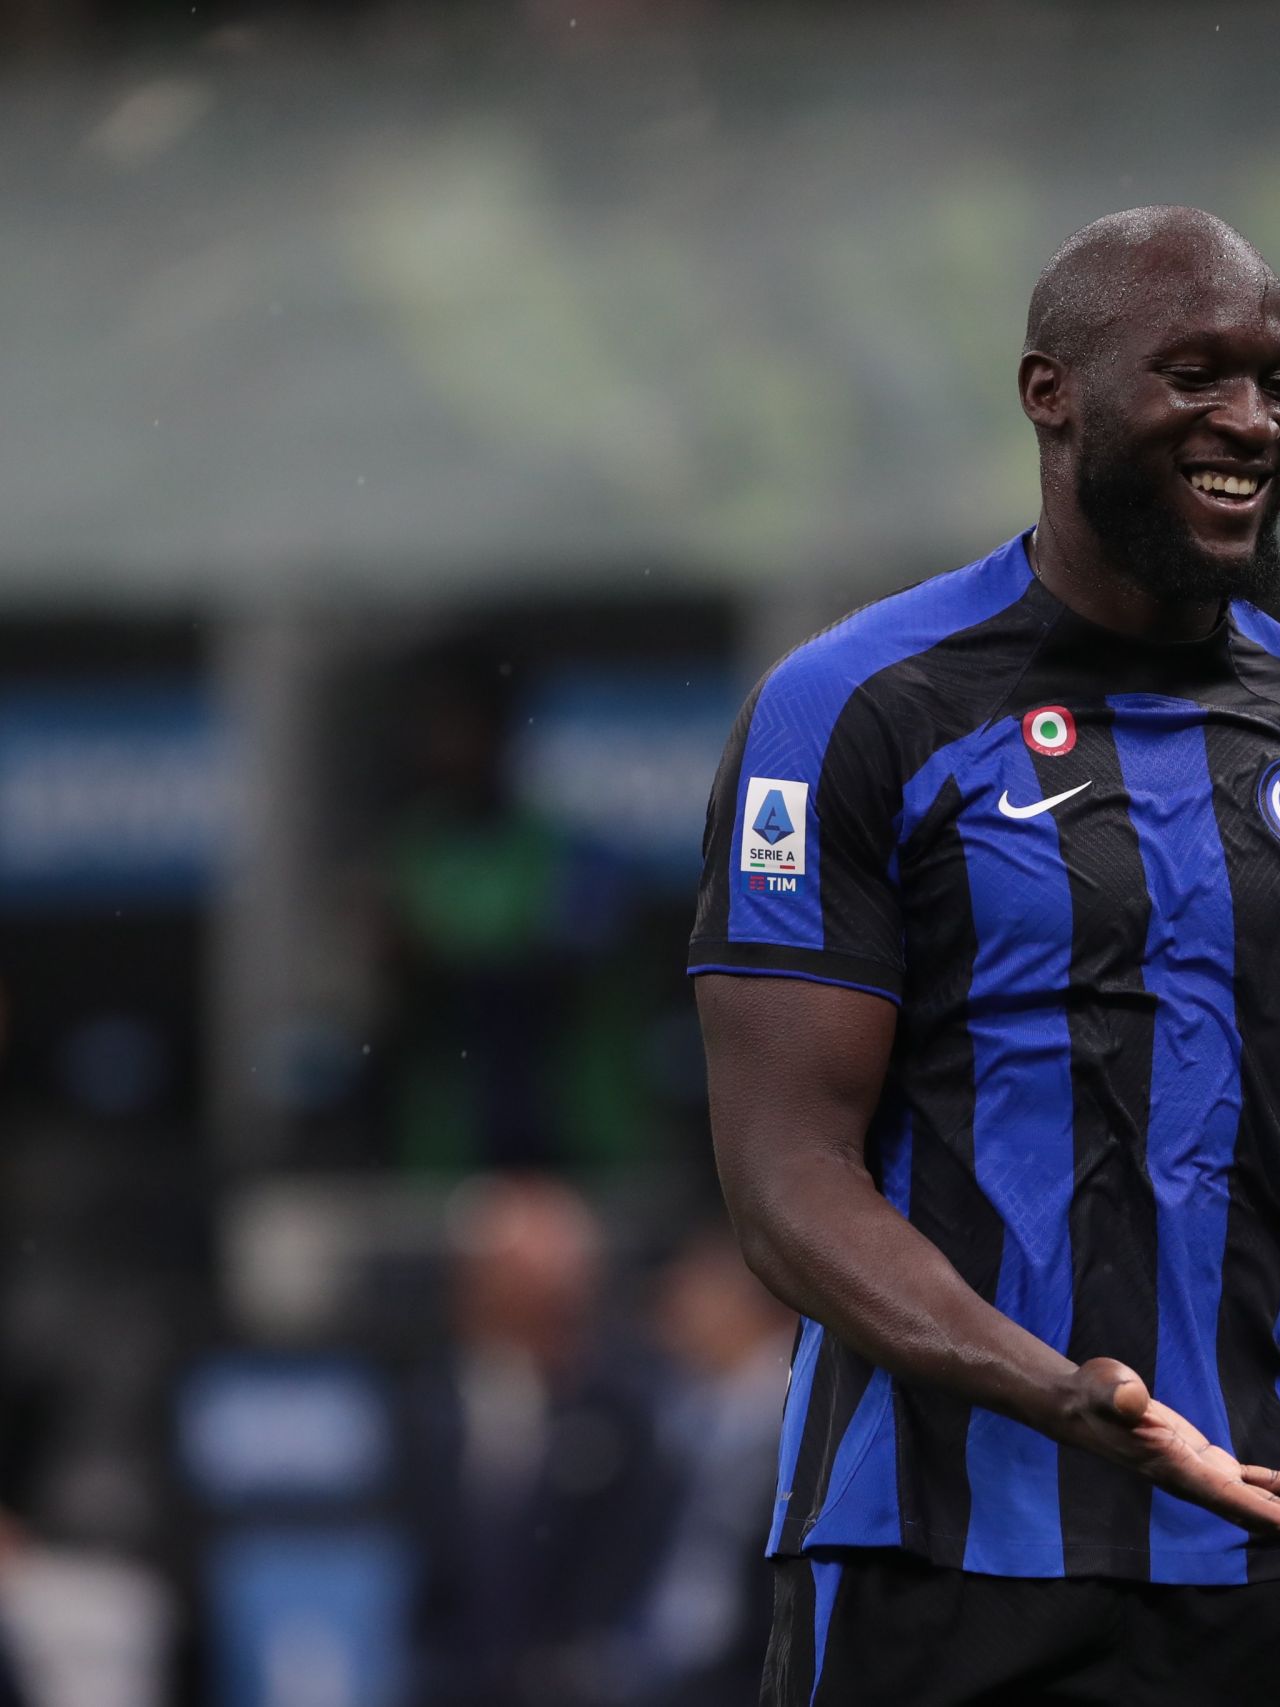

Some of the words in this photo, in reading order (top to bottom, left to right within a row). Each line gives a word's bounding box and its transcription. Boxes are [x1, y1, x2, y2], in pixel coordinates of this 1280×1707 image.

[750, 848, 783, 861] SERIE
[786, 851, 795, 862] A
[767, 876, 796, 892] TIM
